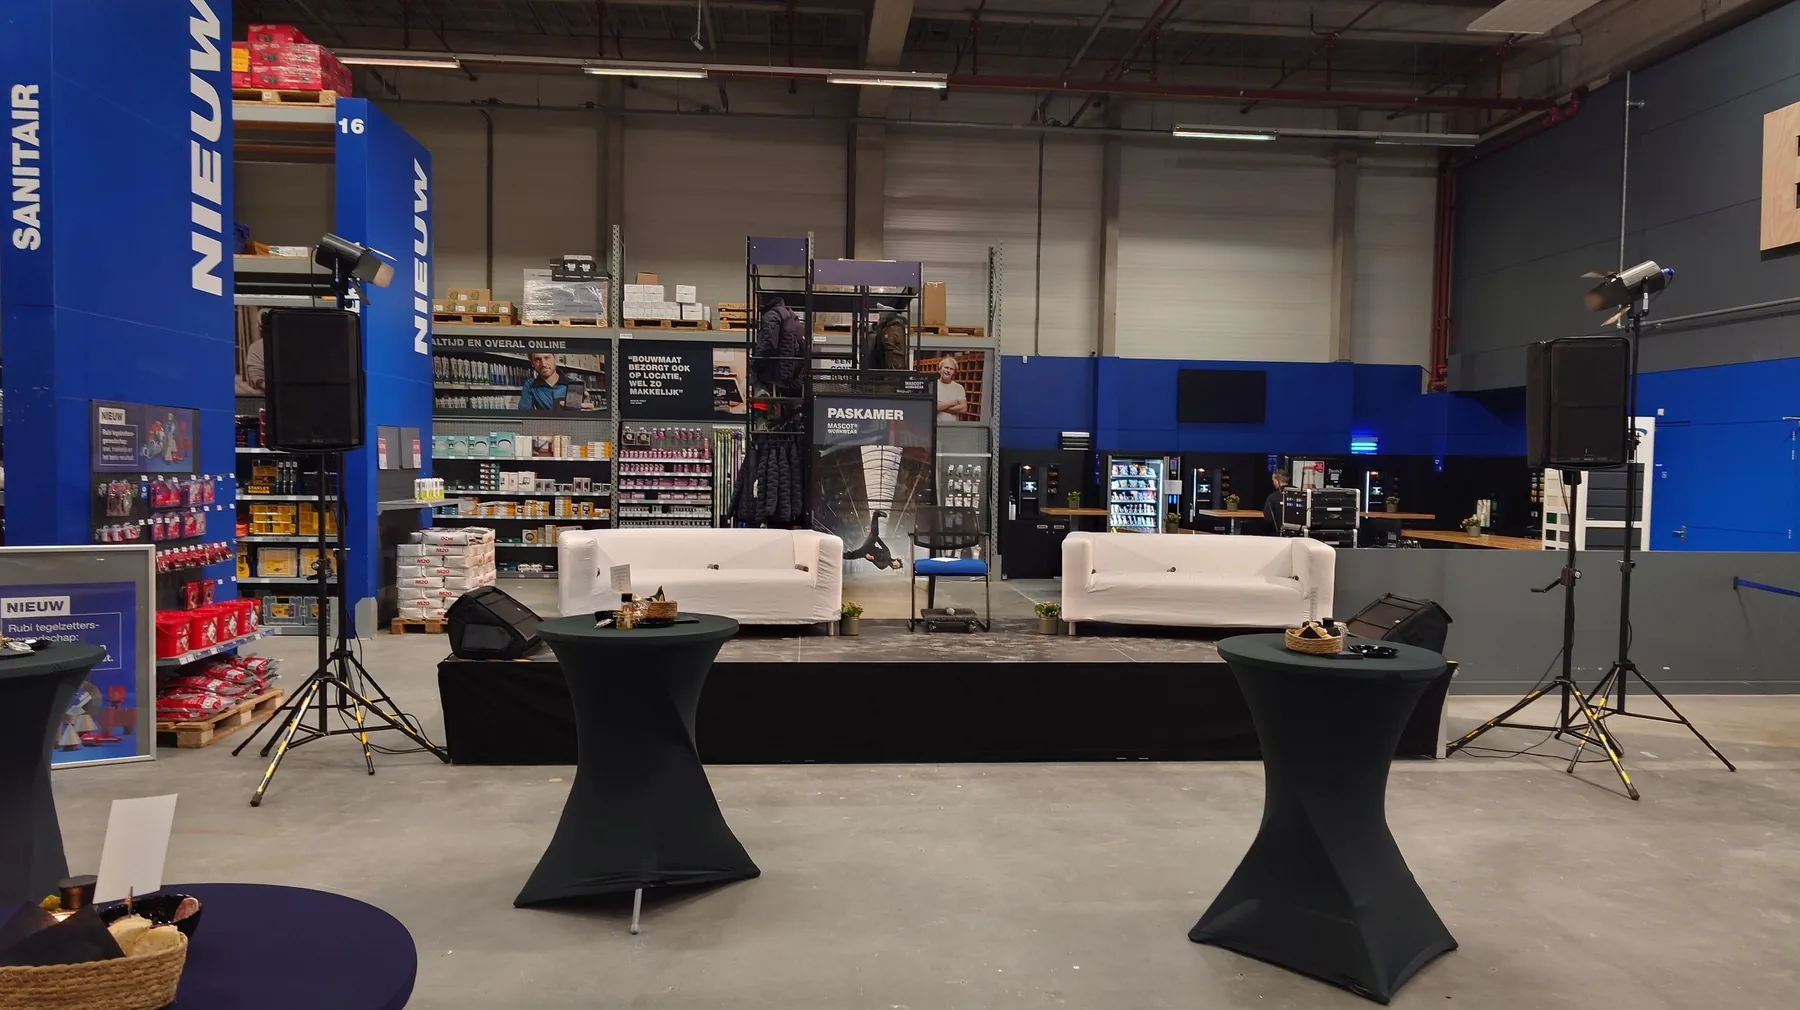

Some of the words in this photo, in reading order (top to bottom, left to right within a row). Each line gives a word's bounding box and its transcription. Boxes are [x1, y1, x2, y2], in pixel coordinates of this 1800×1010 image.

[338, 118, 365, 135] 16
[189, 0, 223, 296] NIEUW
[11, 84, 42, 251] SANITAIR
[413, 158, 429, 356] NIEUW
[431, 337, 464, 346] ALTIJD
[467, 338, 481, 347] EN
[485, 339, 525, 348] OVERAL
[528, 340, 566, 349] ONLINE
[628, 355, 682, 364] “BOUWMAAT
[628, 364, 669, 372] BEZORGT
[671, 364, 691, 372] OOK
[643, 372, 682, 381] LOCATIE,
[629, 388, 683, 396] MAKKELIJK”
[101, 411, 123, 421] NIEUW
[827, 407, 904, 421] PASKAMER
[6, 601, 64, 613] NIEUW
[8, 622, 33, 633] Rubi
[36, 621, 100, 634] tegelzetters-
